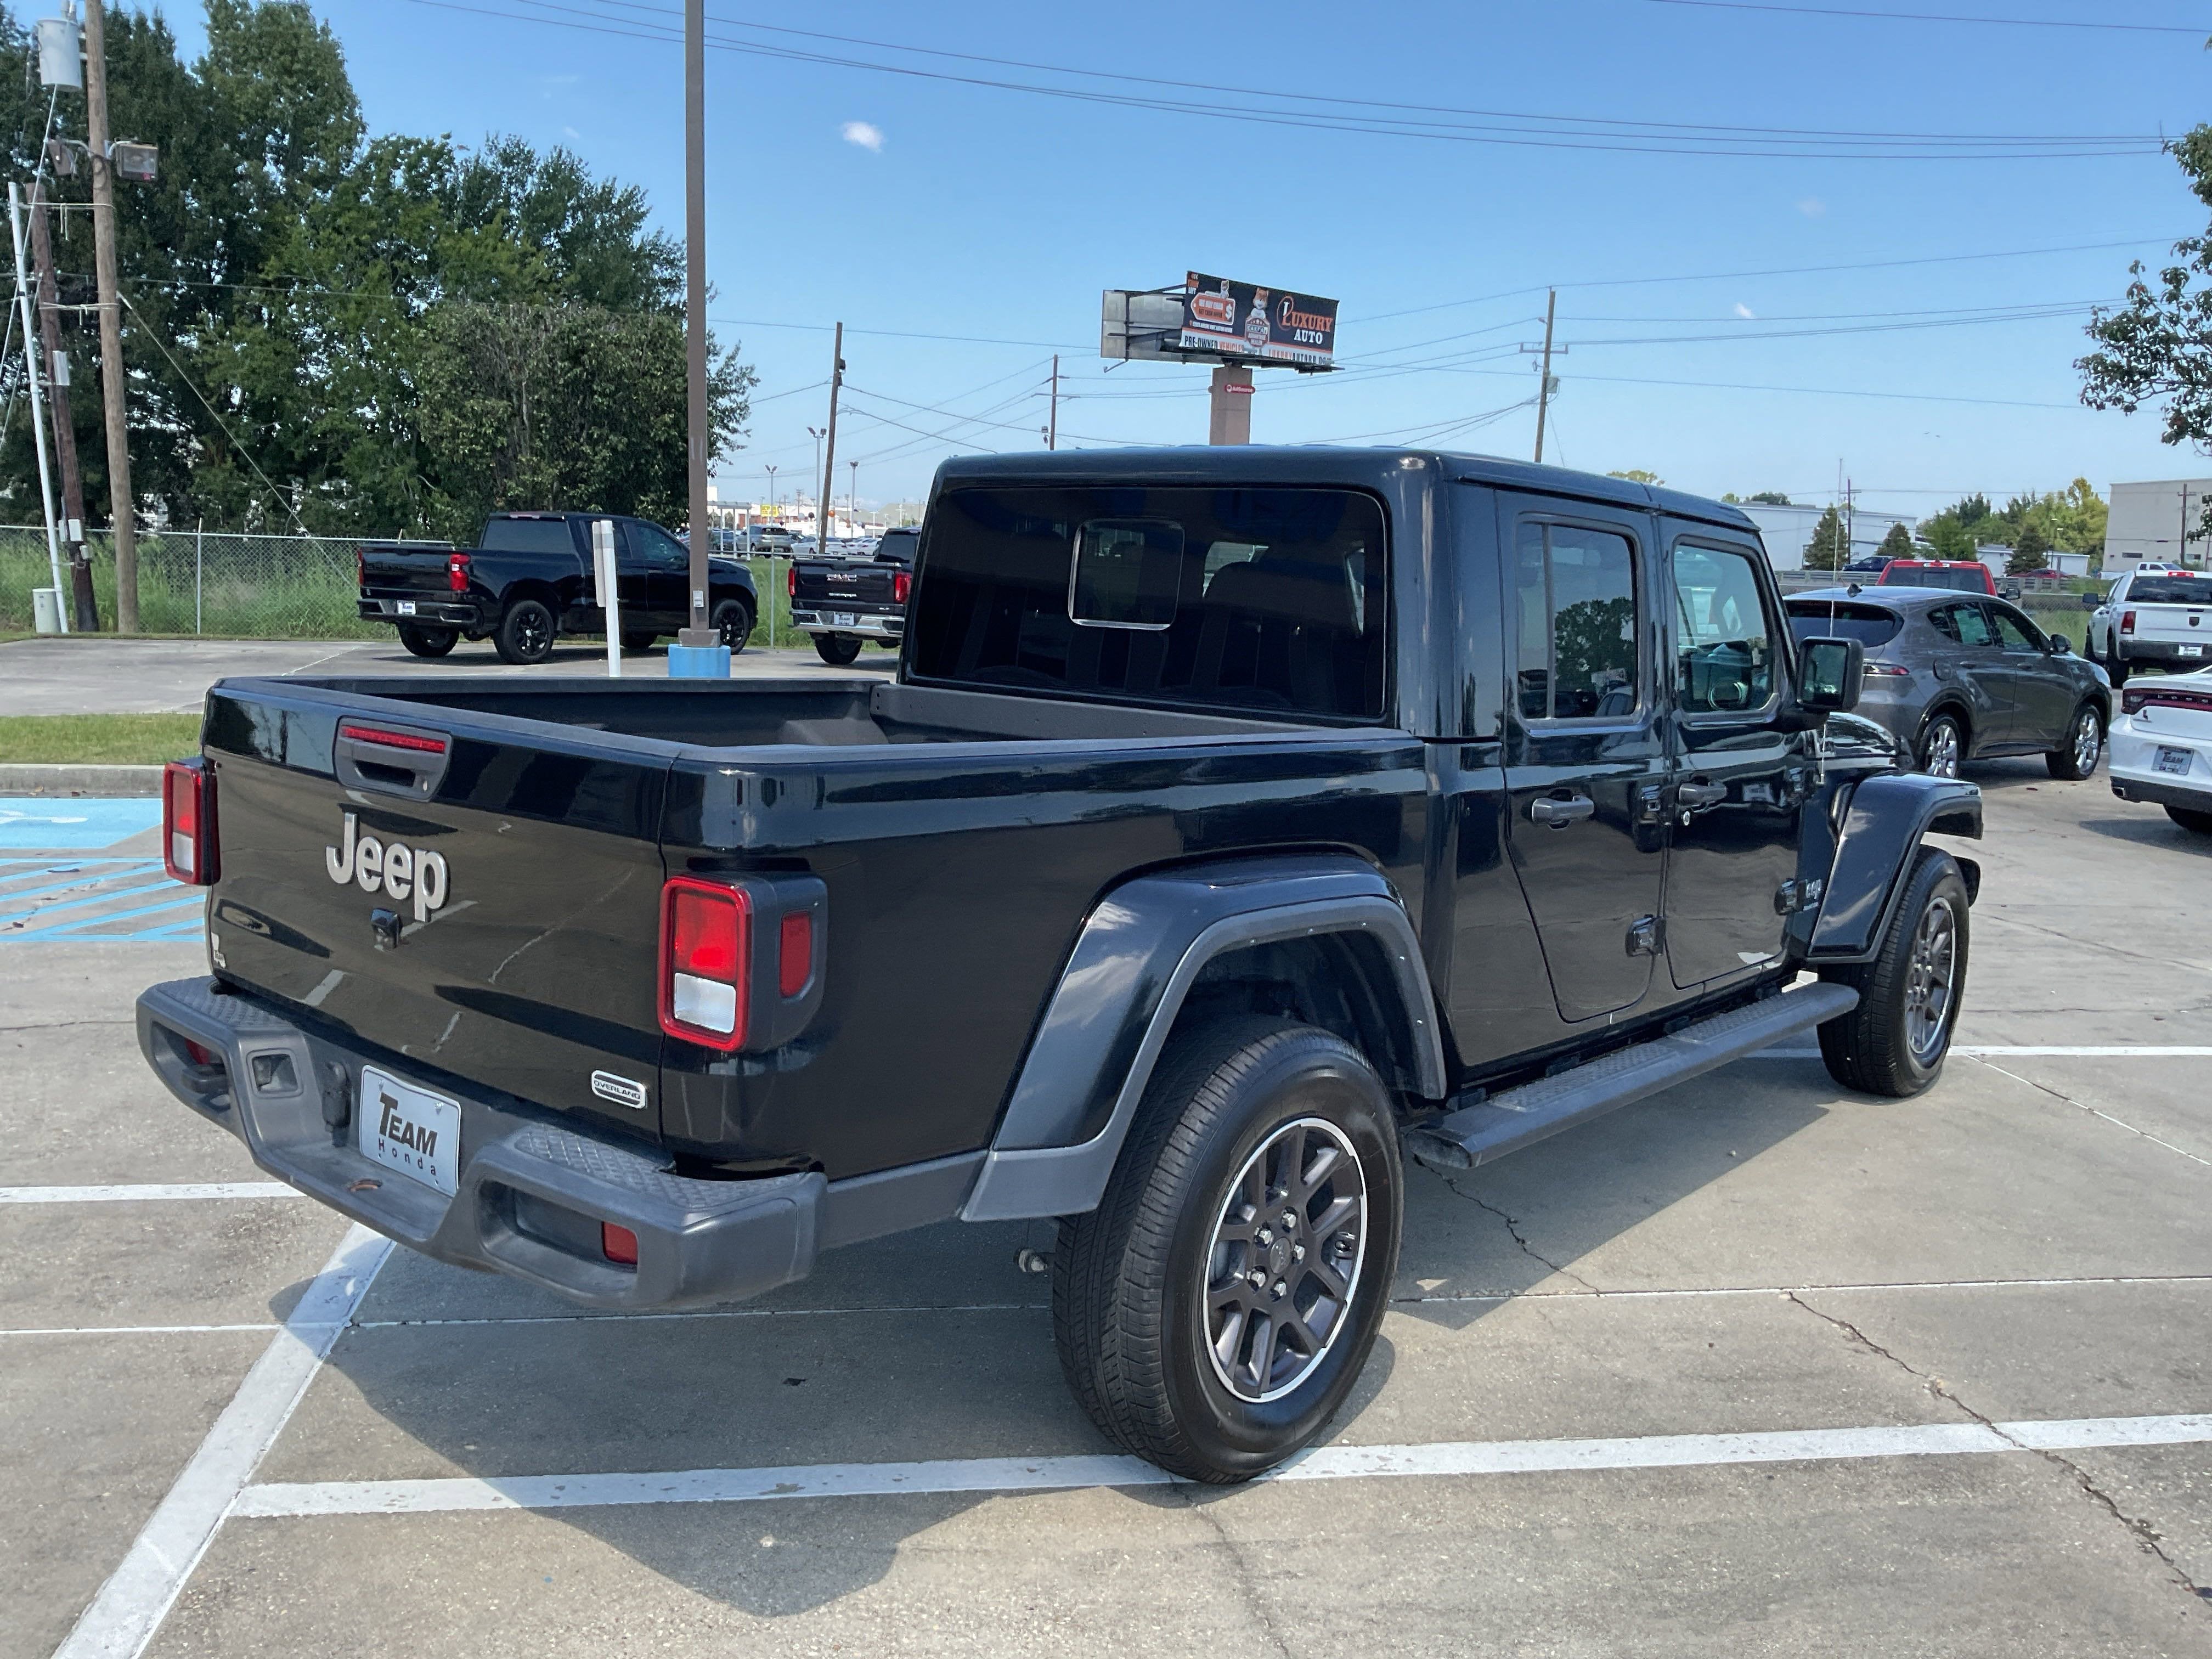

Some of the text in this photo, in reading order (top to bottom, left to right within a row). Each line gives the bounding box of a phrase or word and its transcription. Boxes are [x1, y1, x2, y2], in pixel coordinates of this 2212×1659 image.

[1281, 301, 1333, 332] LUXURY
[1184, 335, 1218, 349] PRE-OWNED
[1294, 329, 1323, 345] AUTO
[326, 811, 448, 922] Jeep
[594, 1080, 640, 1099] OVERLAND
[379, 1092, 438, 1158] TEAM
[378, 1137, 437, 1176] Honda
